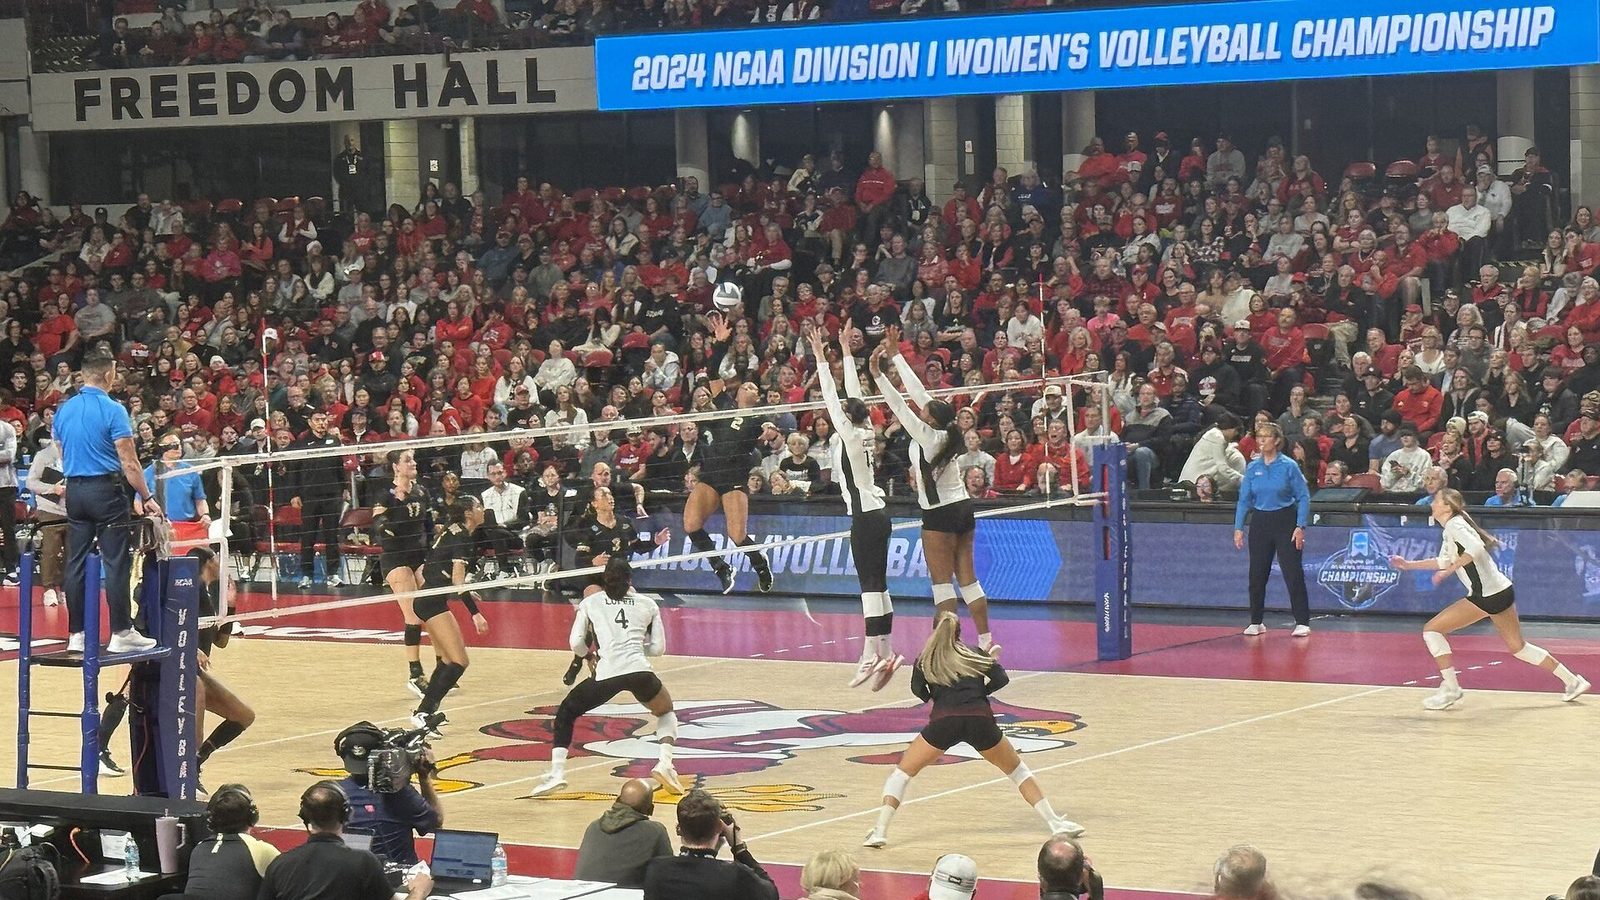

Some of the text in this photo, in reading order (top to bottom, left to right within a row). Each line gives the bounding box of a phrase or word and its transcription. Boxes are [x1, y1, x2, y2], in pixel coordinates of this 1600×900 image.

[632, 54, 706, 90] 2024
[712, 49, 784, 87] NCAA
[792, 42, 919, 83] DIVISION
[946, 33, 1090, 75] WOMEN'S
[1099, 23, 1281, 68] VOLLEYBALL
[1291, 6, 1555, 59] CHAMPIONSHIP
[74, 57, 557, 122] FREEDOM HALL
[1320, 569, 1398, 584] CHAMPIONSHIP
[614, 607, 629, 630] 4
